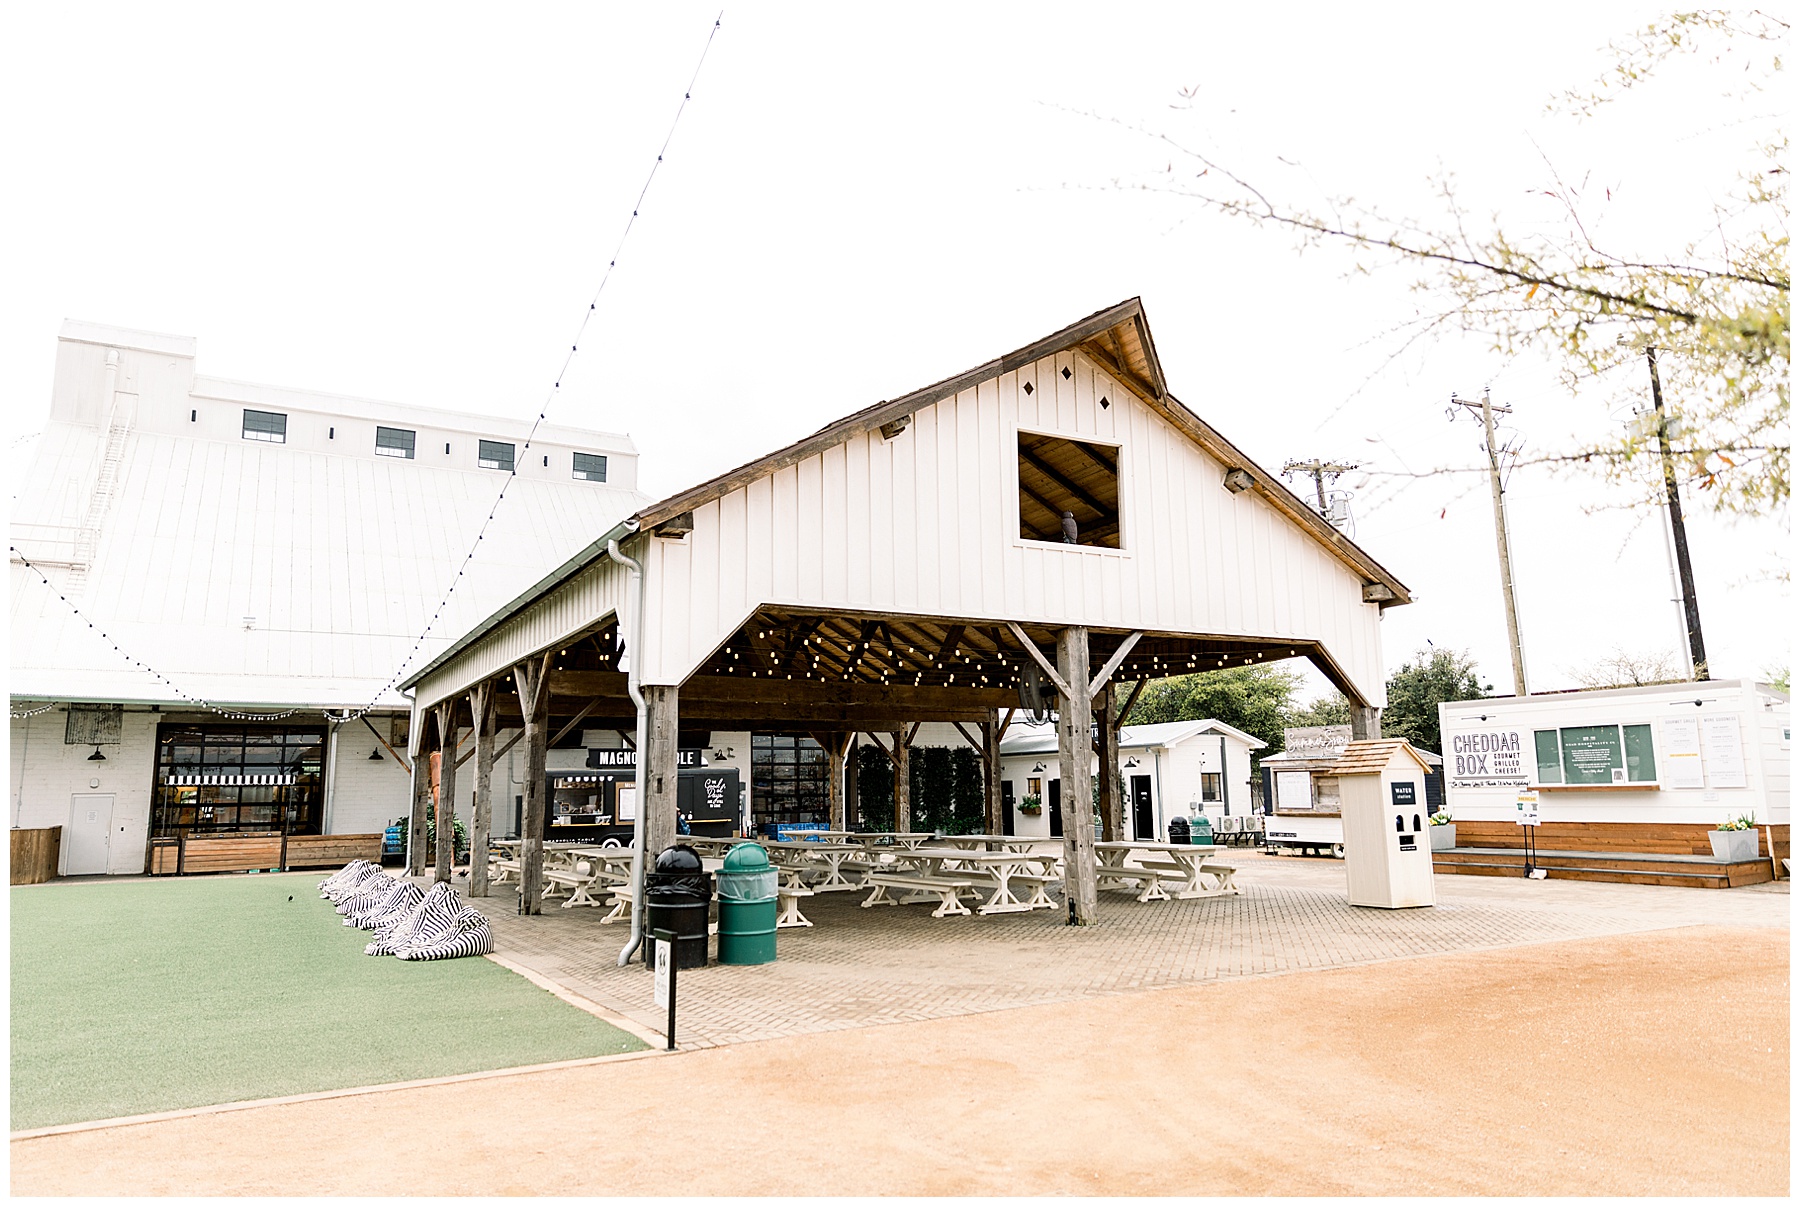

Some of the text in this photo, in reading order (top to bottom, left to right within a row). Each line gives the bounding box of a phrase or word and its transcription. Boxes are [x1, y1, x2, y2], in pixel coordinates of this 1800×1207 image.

[1287, 733, 1325, 752] Summer
[1453, 732, 1520, 753] CHEDDAR
[600, 752, 637, 765] MAGNO
[1456, 754, 1489, 775] BOX
